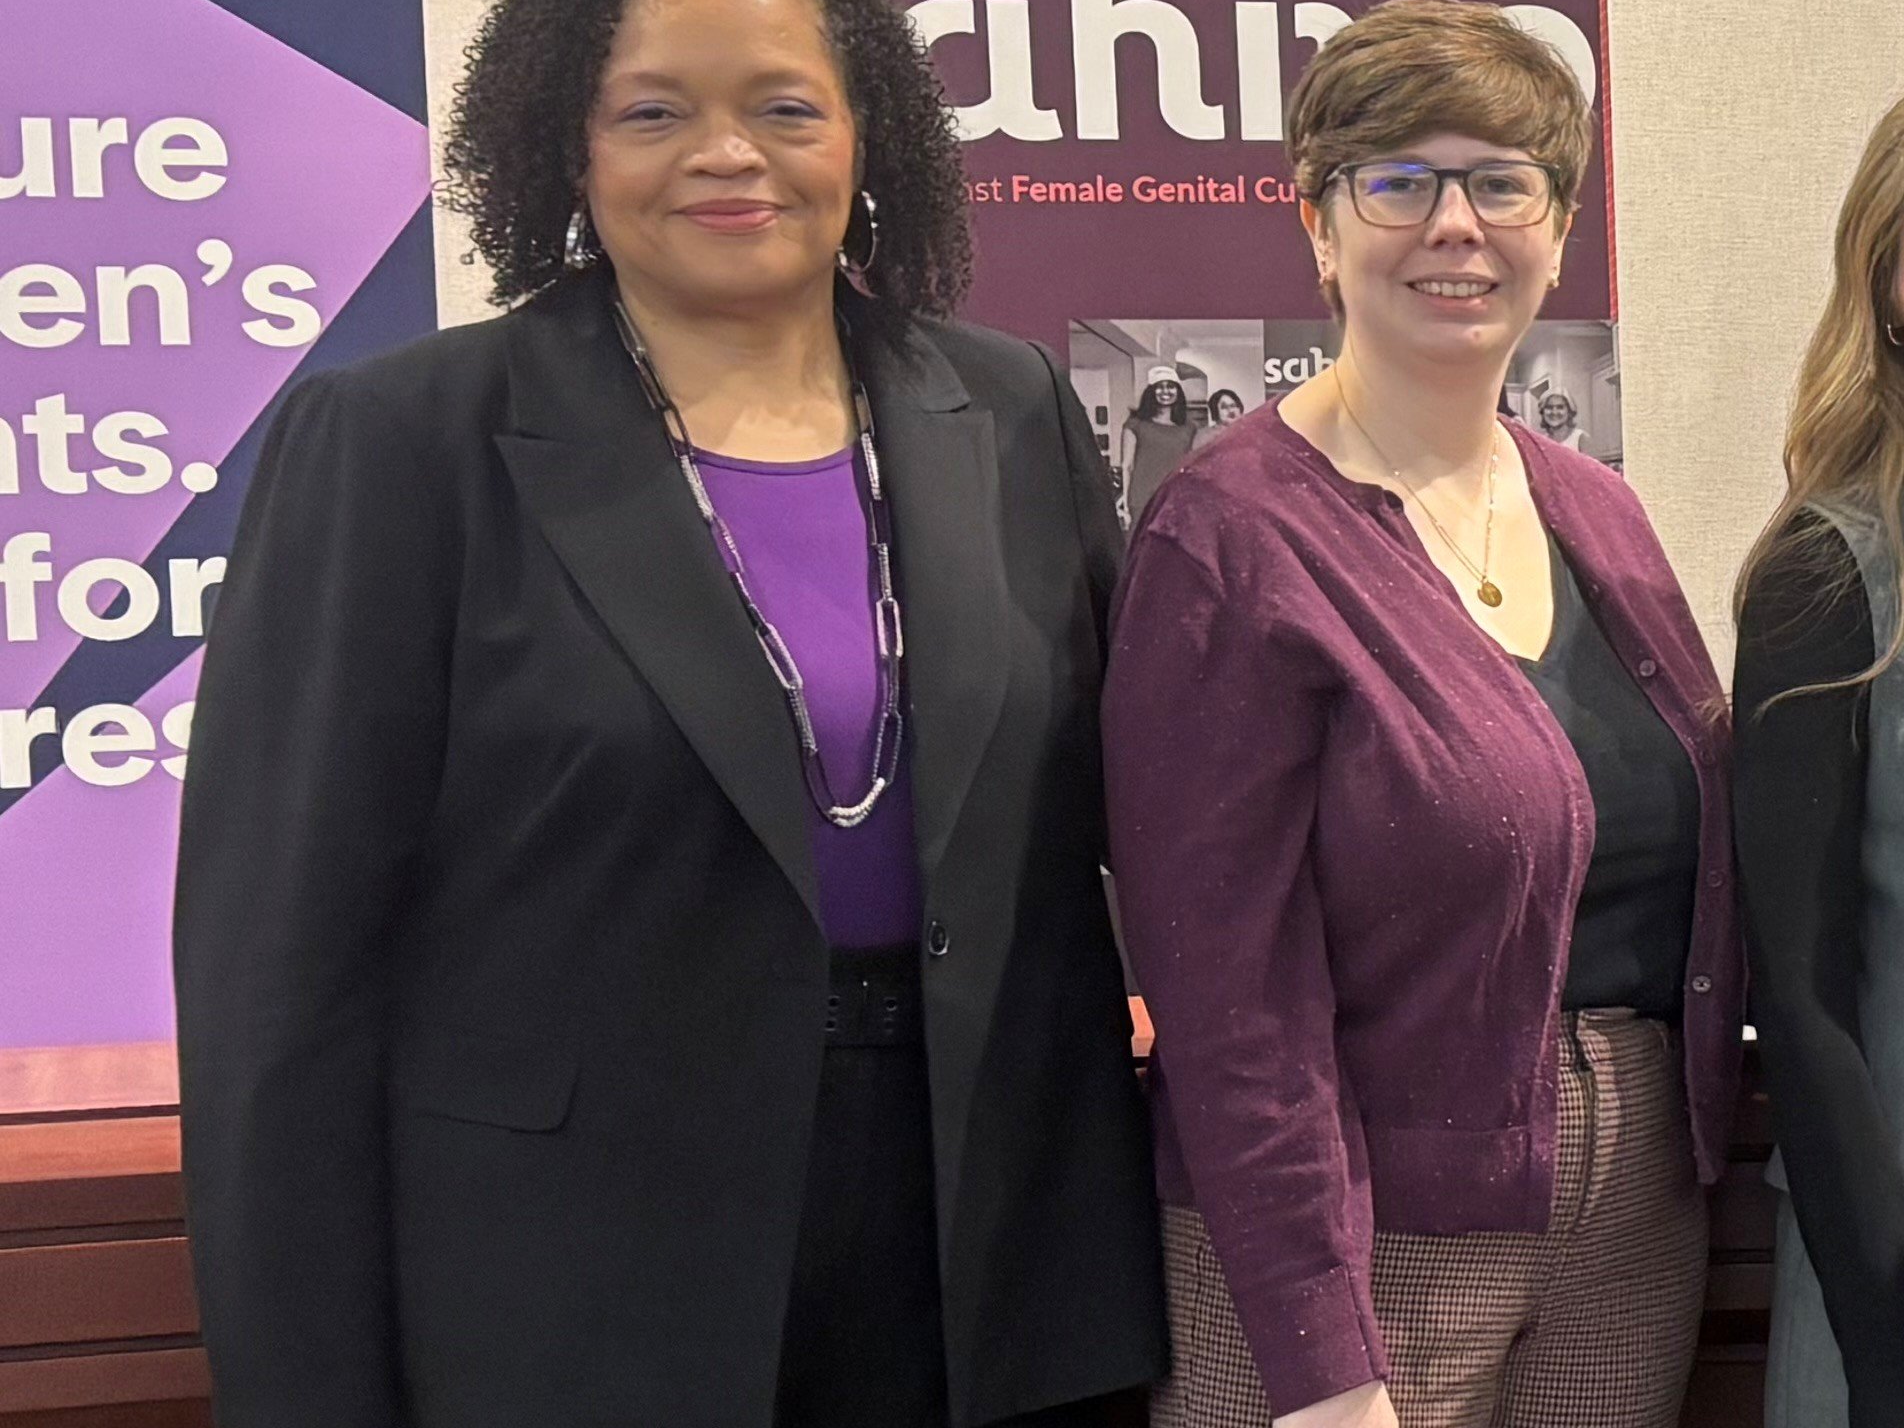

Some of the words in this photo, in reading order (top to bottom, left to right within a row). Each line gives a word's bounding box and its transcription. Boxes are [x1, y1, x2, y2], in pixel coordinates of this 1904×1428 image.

[1012, 174, 1124, 203] Female
[1131, 174, 1245, 204] Genital
[0, 530, 227, 642] for
